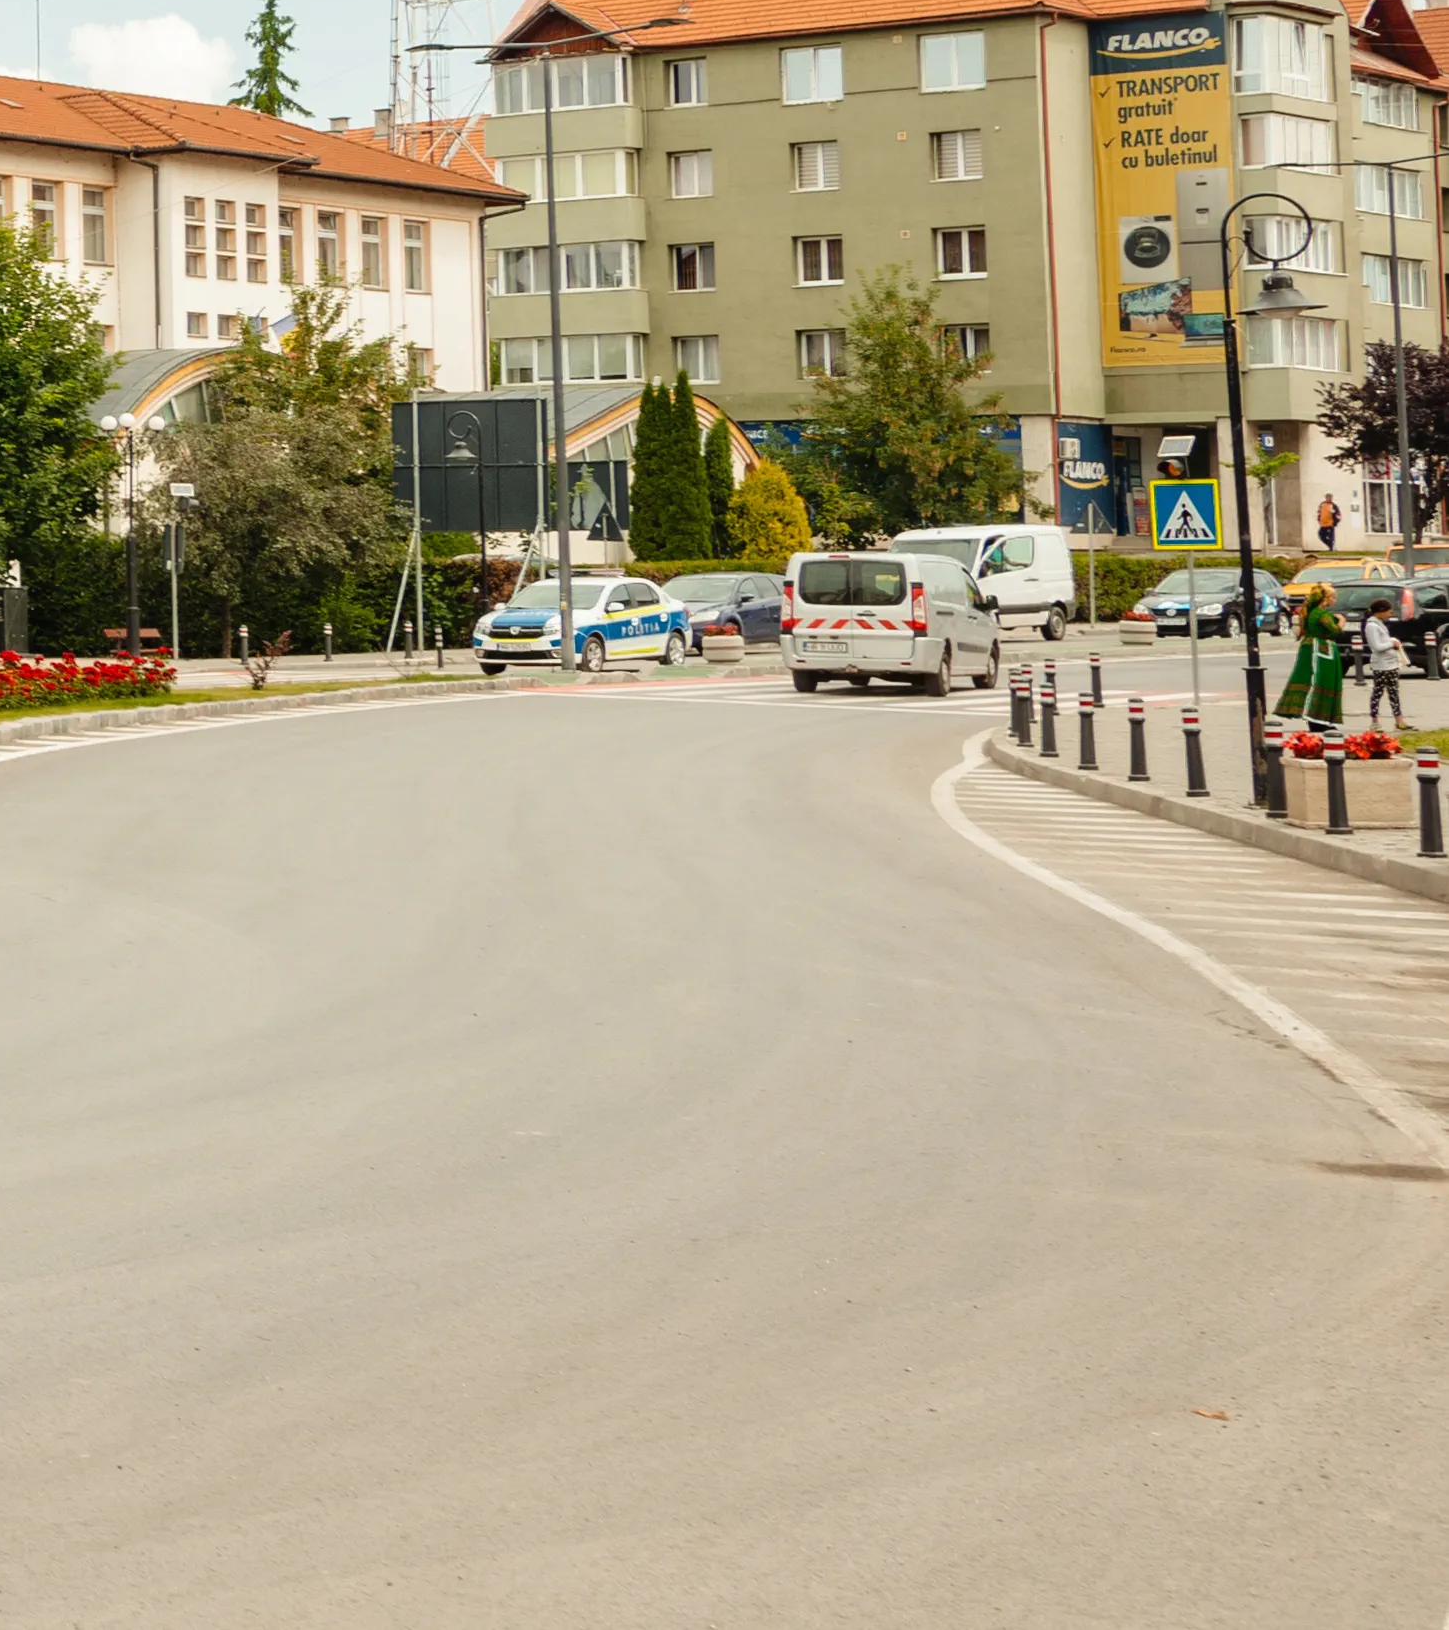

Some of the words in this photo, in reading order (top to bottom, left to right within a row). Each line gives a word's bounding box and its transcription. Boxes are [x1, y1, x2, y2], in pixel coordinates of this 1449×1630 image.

[1107, 27, 1210, 52] FLANCO
[1116, 72, 1220, 98] TRANSPORT
[1121, 128, 1164, 148] RATE
[1170, 125, 1209, 144] doar
[1121, 156, 1139, 169] cu
[1144, 143, 1218, 167] buletinul
[1062, 460, 1106, 480] FLANCO
